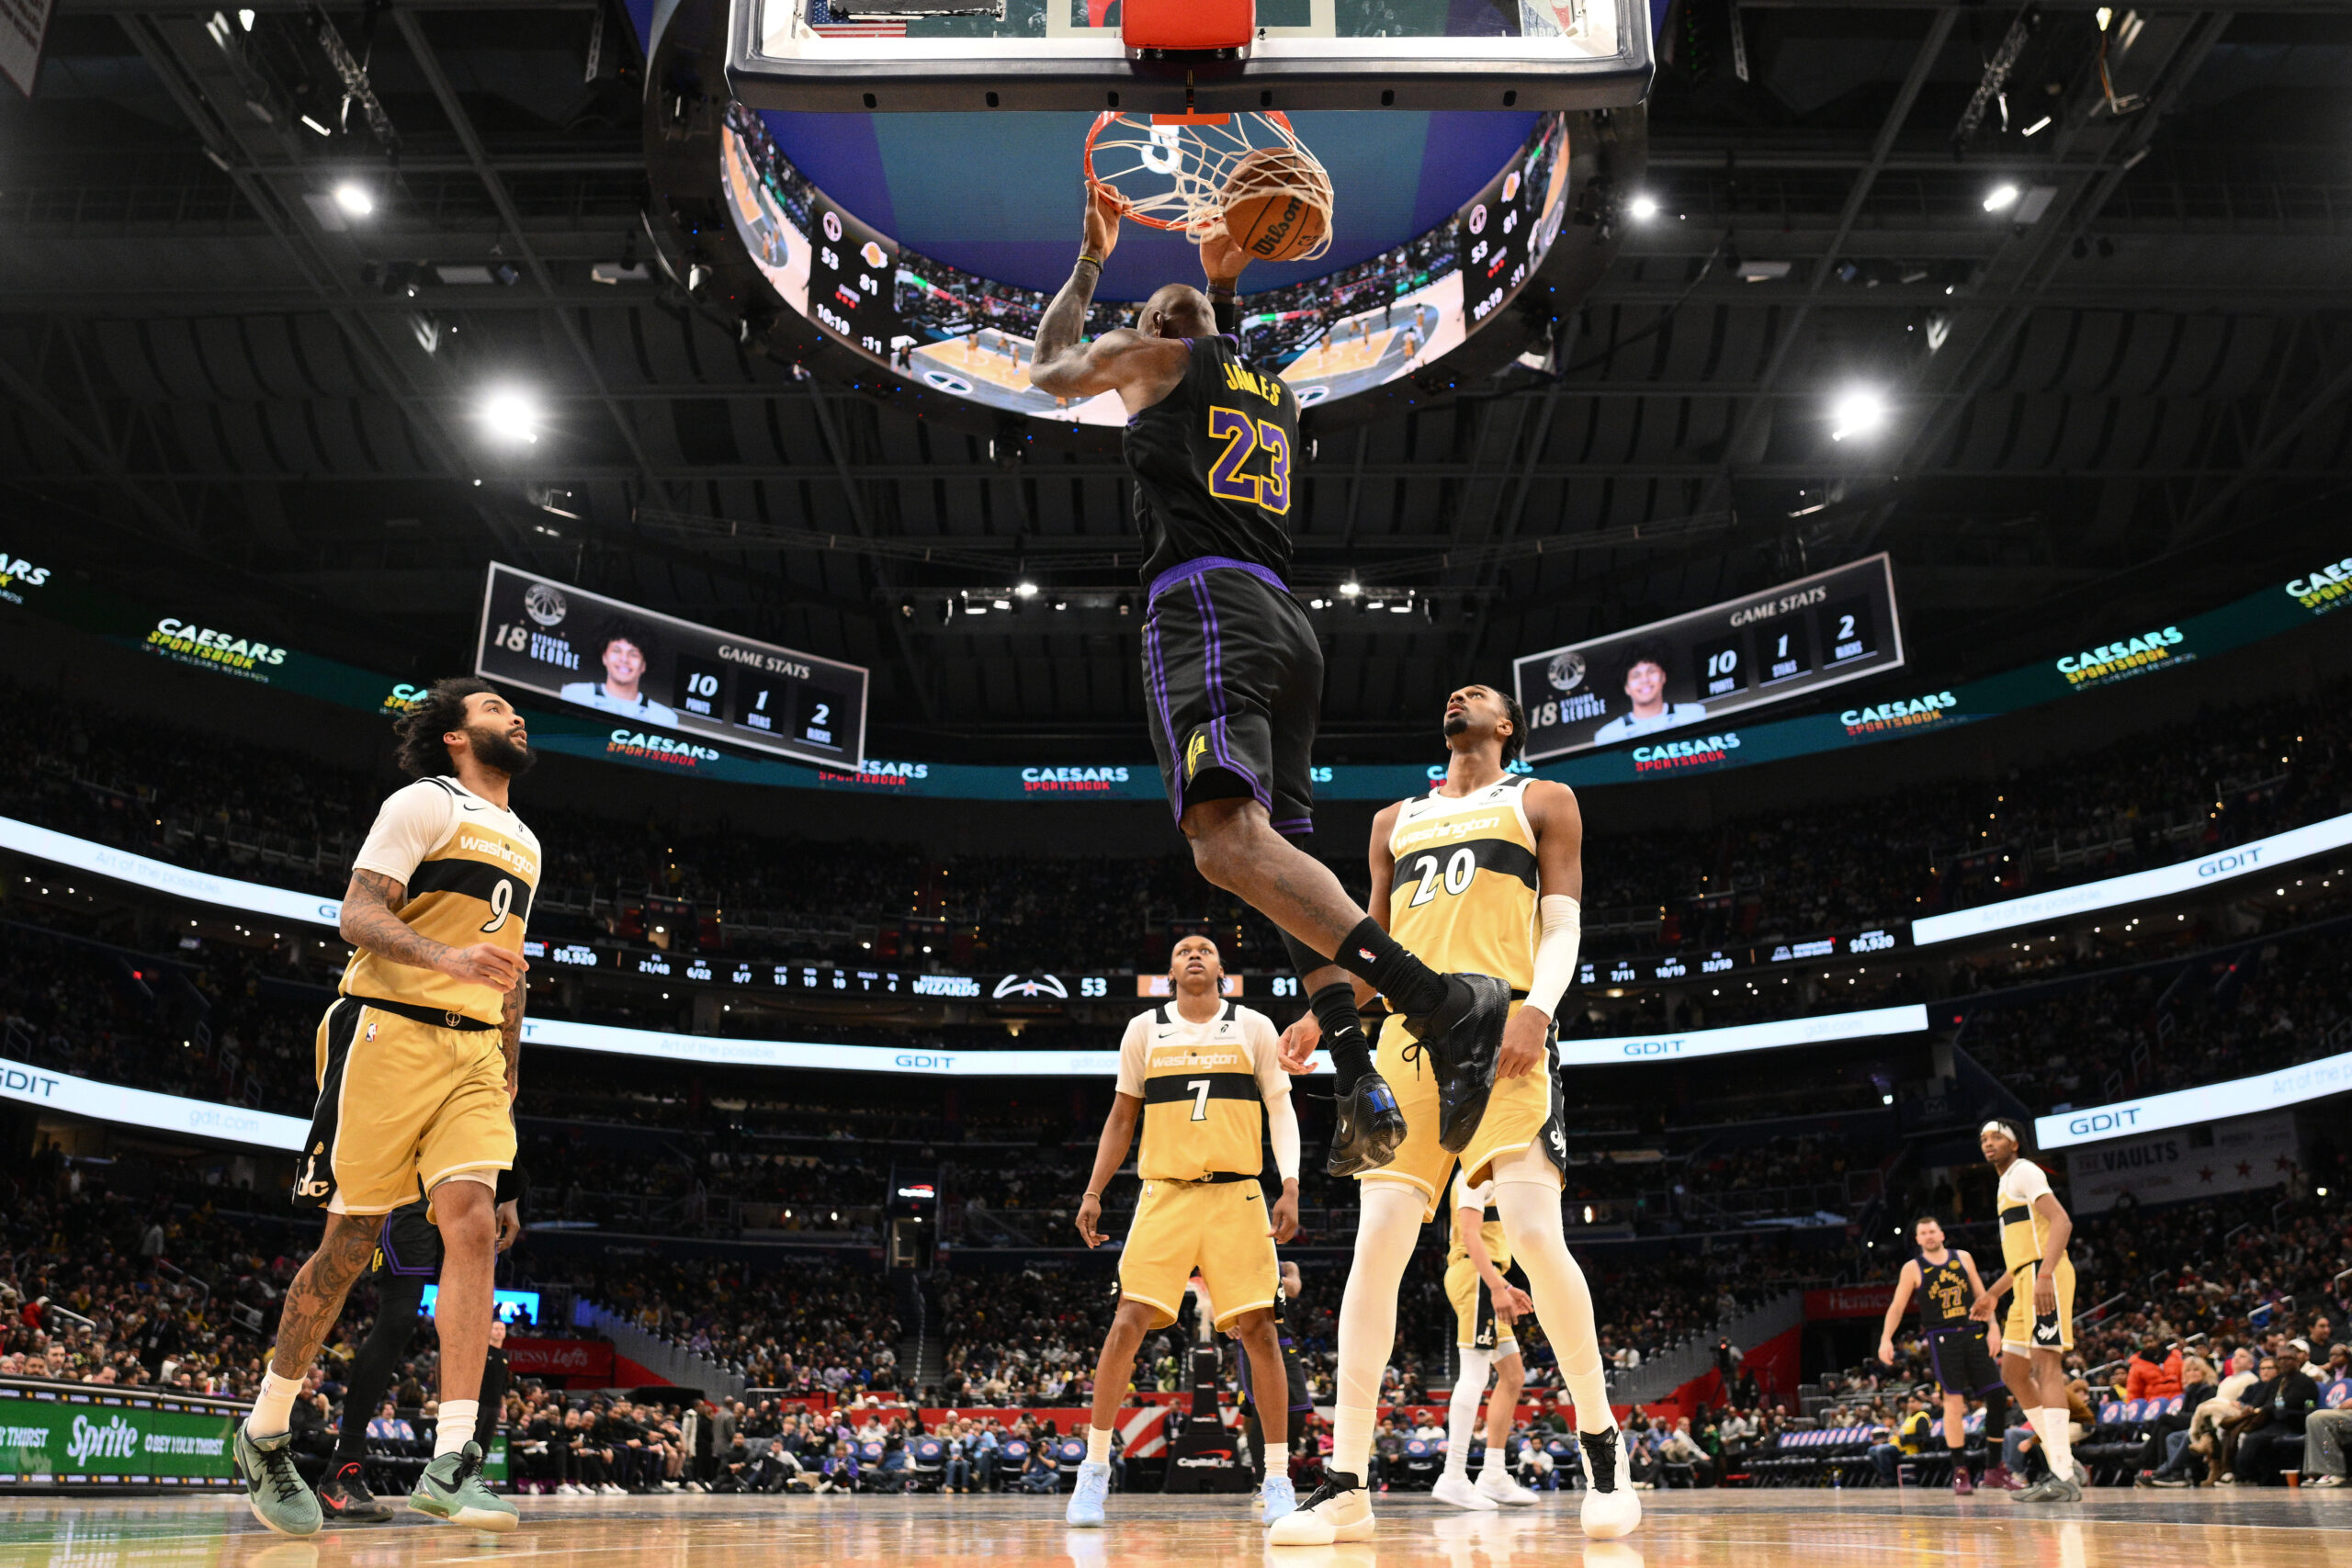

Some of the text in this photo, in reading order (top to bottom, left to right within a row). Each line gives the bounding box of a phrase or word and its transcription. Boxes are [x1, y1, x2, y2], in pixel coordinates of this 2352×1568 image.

[1251, 196, 1304, 255] Wilson
[1503, 209, 1518, 234] 81
[821, 246, 839, 270] 53
[1471, 240, 1487, 265] 53
[859, 274, 877, 296] 81
[1473, 287, 1503, 321] 10:19
[817, 303, 850, 335] 10:19
[1223, 363, 1281, 406] JAMES
[1208, 405, 1291, 515] 23
[2286, 558, 2352, 598] CAES
[1730, 585, 1826, 627] GAME STATS
[494, 623, 527, 652] 18
[1838, 615, 1855, 640] 2
[147, 630, 255, 671] SPORTSBOOK
[158, 617, 287, 665] CAESARS
[1778, 634, 1788, 658] 1
[2057, 626, 2183, 673] CAESARS
[530, 642, 580, 671] GEORGE
[718, 645, 810, 680] GAME STATS
[1708, 649, 1737, 678] 10
[2065, 647, 2169, 683] SPORTSBOOK
[687, 672, 718, 697] 10
[755, 691, 769, 711] 1
[1561, 698, 1606, 724] GEORGE
[1840, 691, 1957, 727] CAESARS
[811, 704, 830, 725] 2
[1531, 702, 1557, 729] 18
[1846, 708, 1943, 737] SPORTSBOOK
[606, 741, 696, 767] SPORTSBOOK
[611, 729, 719, 761] CAESARS
[1633, 733, 1741, 763] CAESARS
[860, 760, 928, 779] ESARS
[1635, 750, 1726, 773] SPORTSBOOK
[1022, 766, 1129, 783] CAESARS
[1023, 781, 1111, 791] SPORTSBOOK
[1396, 817, 1499, 849] washington
[96, 851, 117, 867] Art
[119, 859, 134, 873] of
[138, 863, 160, 881] the
[460, 835, 537, 878] washington
[2197, 847, 2264, 878] GDIT
[1408, 847, 1476, 908] 20
[480, 878, 513, 933] 9
[1982, 910, 2000, 924] Art
[1850, 935, 1894, 953] $9,920
[553, 949, 596, 965] $9,920
[639, 962, 670, 975] 21/48
[1702, 958, 1732, 972] 32/50
[686, 967, 711, 980] 6/22
[733, 972, 751, 983] 5/7
[775, 975, 787, 985] 13
[803, 976, 817, 987] 19
[1611, 970, 1634, 982] 7/11
[1656, 965, 1686, 977] 10/19
[864, 980, 869, 990] 1
[888, 982, 897, 992] 4
[912, 981, 980, 997] WIZARDS
[1080, 978, 1108, 997] 53
[1271, 977, 1296, 997] 81
[661, 1039, 680, 1052] Art
[1623, 1040, 1686, 1056] GDIT
[895, 1054, 956, 1068] GDIT
[1152, 1050, 1238, 1069] washington
[0, 1068, 60, 1097] DIT
[2272, 1078, 2294, 1095] Art
[1186, 1079, 1211, 1122] 7
[189, 1108, 259, 1133] gdit.com
[2069, 1107, 2142, 1135] GDIT
[2103, 1141, 2178, 1171] VAULTS
[1828, 1292, 1891, 1311] Hennes
[1938, 1285, 1962, 1310] 77
[508, 1347, 588, 1368] nessy Lofts
[6, 1427, 49, 1449] THIRST
[67, 1415, 138, 1467] Sprite
[144, 1434, 171, 1453] OBEY
[196, 1438, 225, 1456] THIRST
